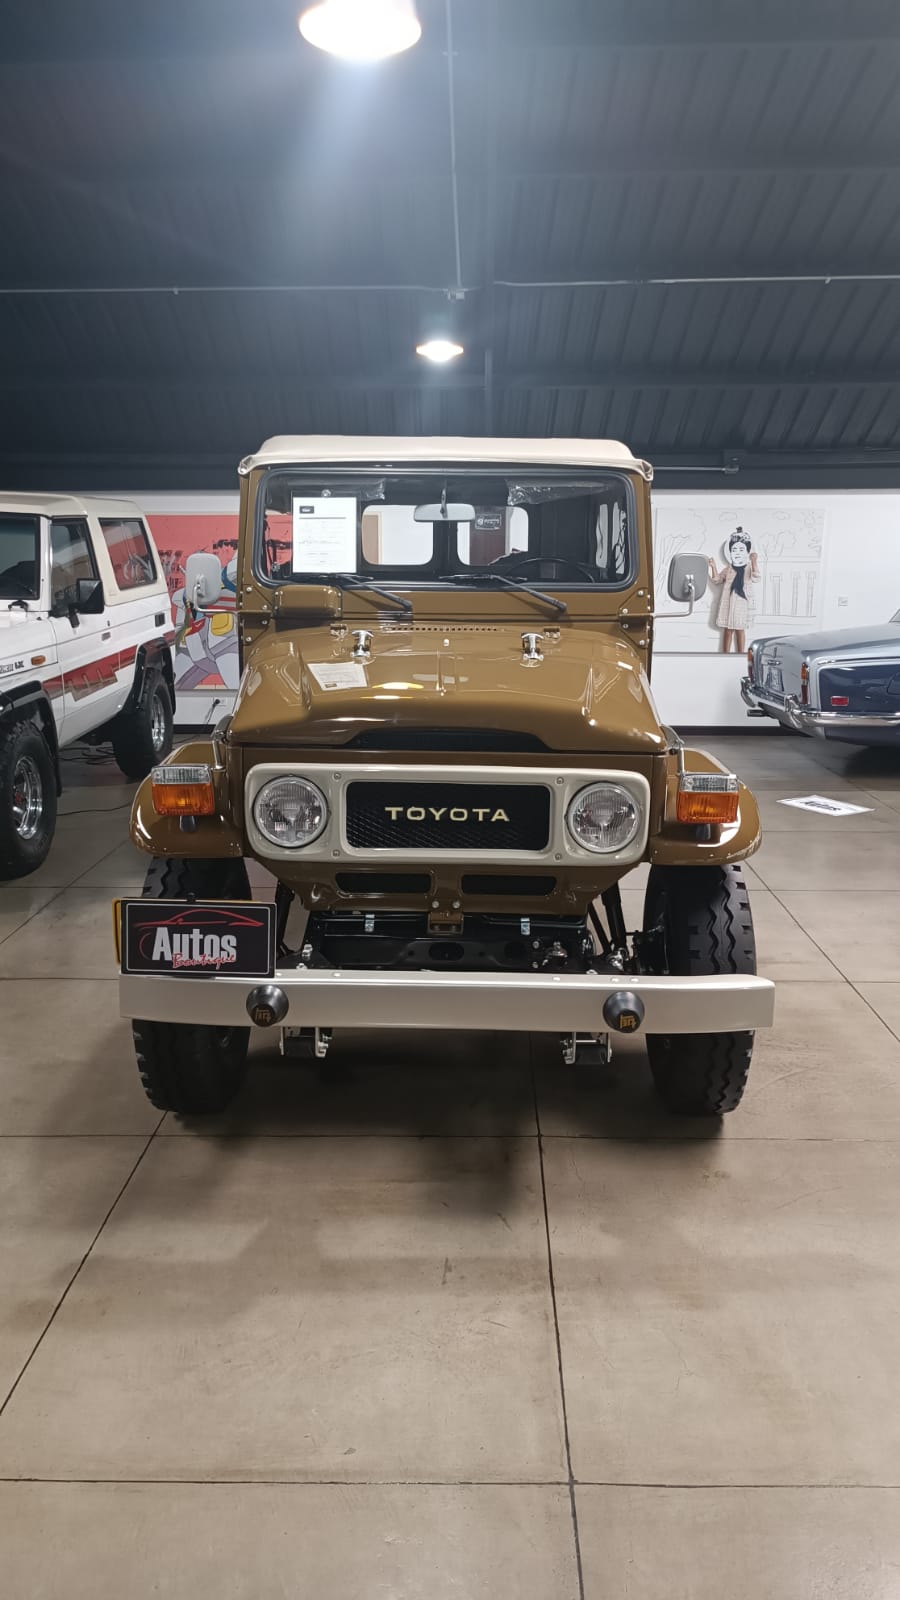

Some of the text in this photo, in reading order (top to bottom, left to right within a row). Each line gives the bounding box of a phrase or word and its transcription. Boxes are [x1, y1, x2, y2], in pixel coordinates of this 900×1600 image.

[384, 806, 510, 822] TOYOTA
[152, 927, 236, 961] Autos
[172, 953, 235, 970] Boutique
